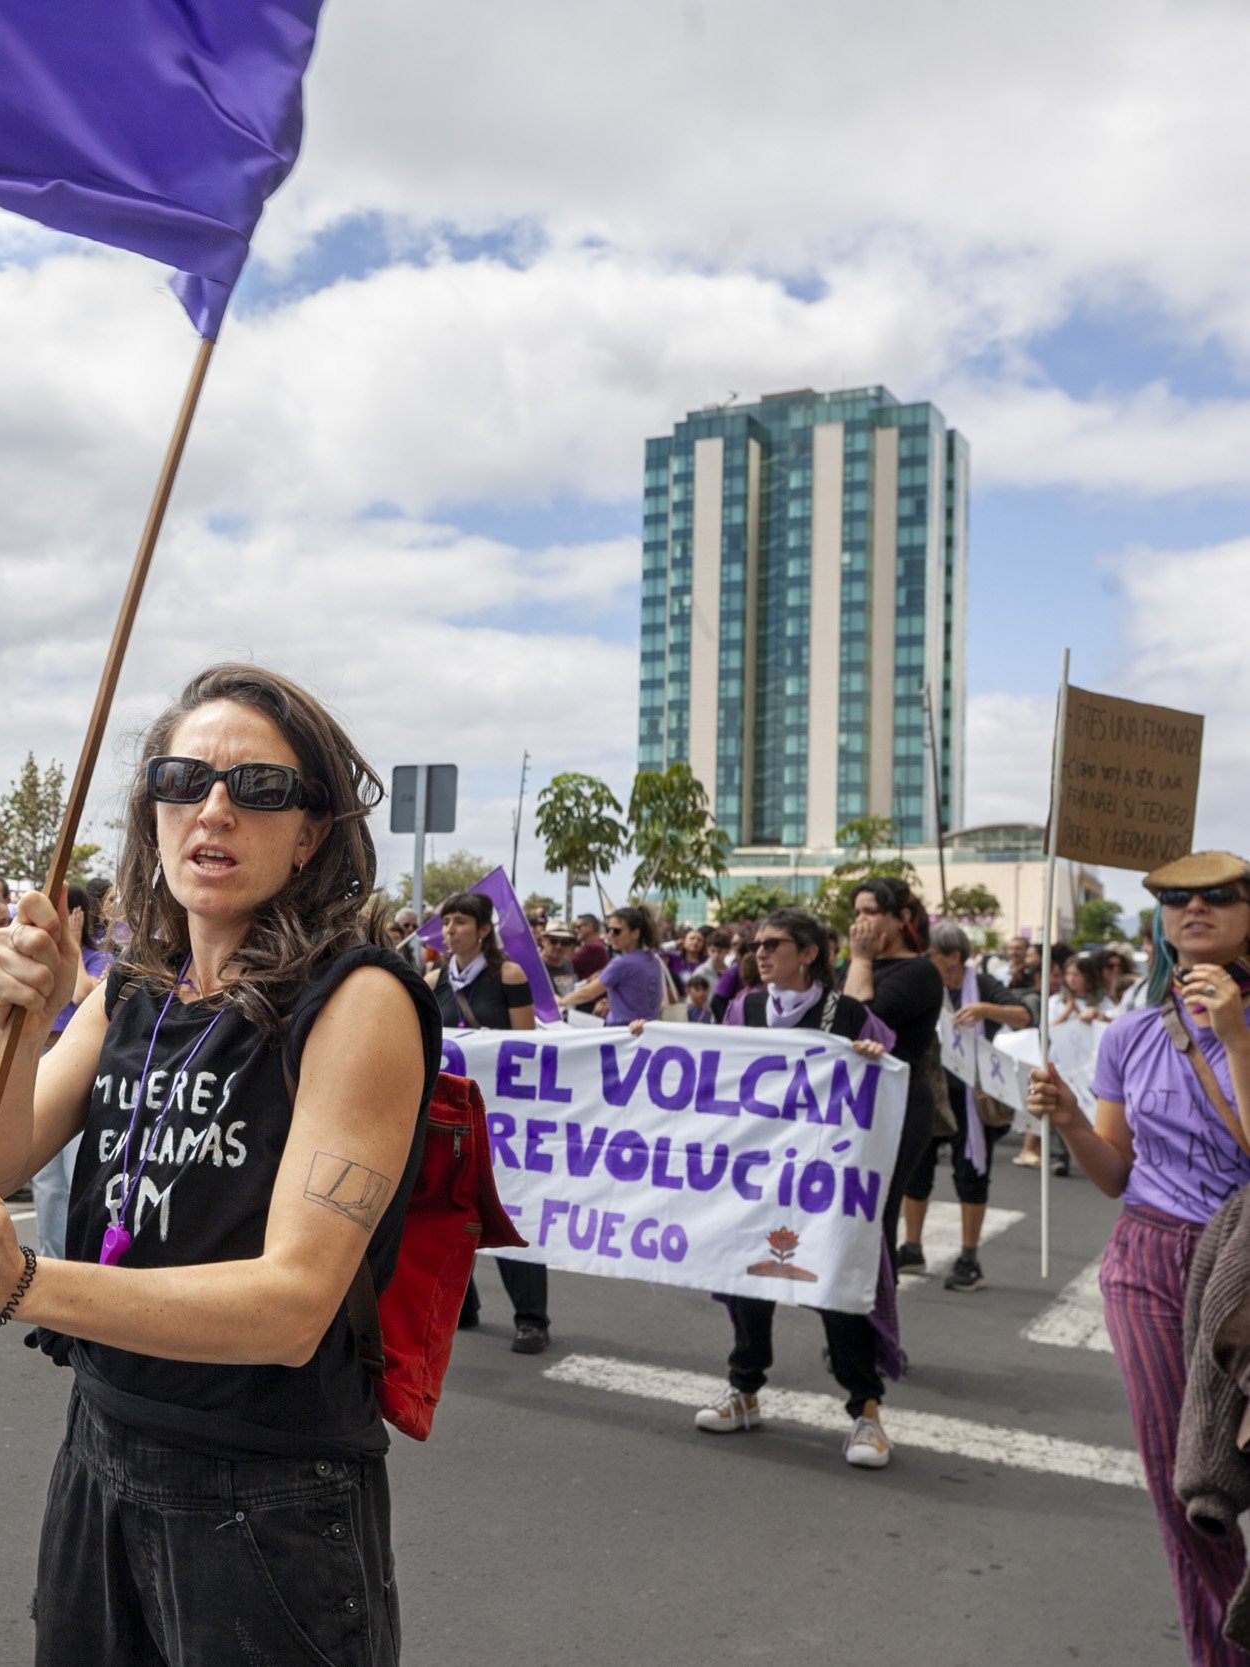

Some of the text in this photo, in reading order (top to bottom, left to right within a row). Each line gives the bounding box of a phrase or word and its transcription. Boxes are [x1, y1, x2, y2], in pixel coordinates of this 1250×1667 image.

[1142, 801, 1190, 827] TENGO
[1099, 825, 1109, 855] Y
[496, 1040, 572, 1102] EL
[600, 1046, 881, 1130] VOLCÁN
[538, 1199, 688, 1263] FUEGO
